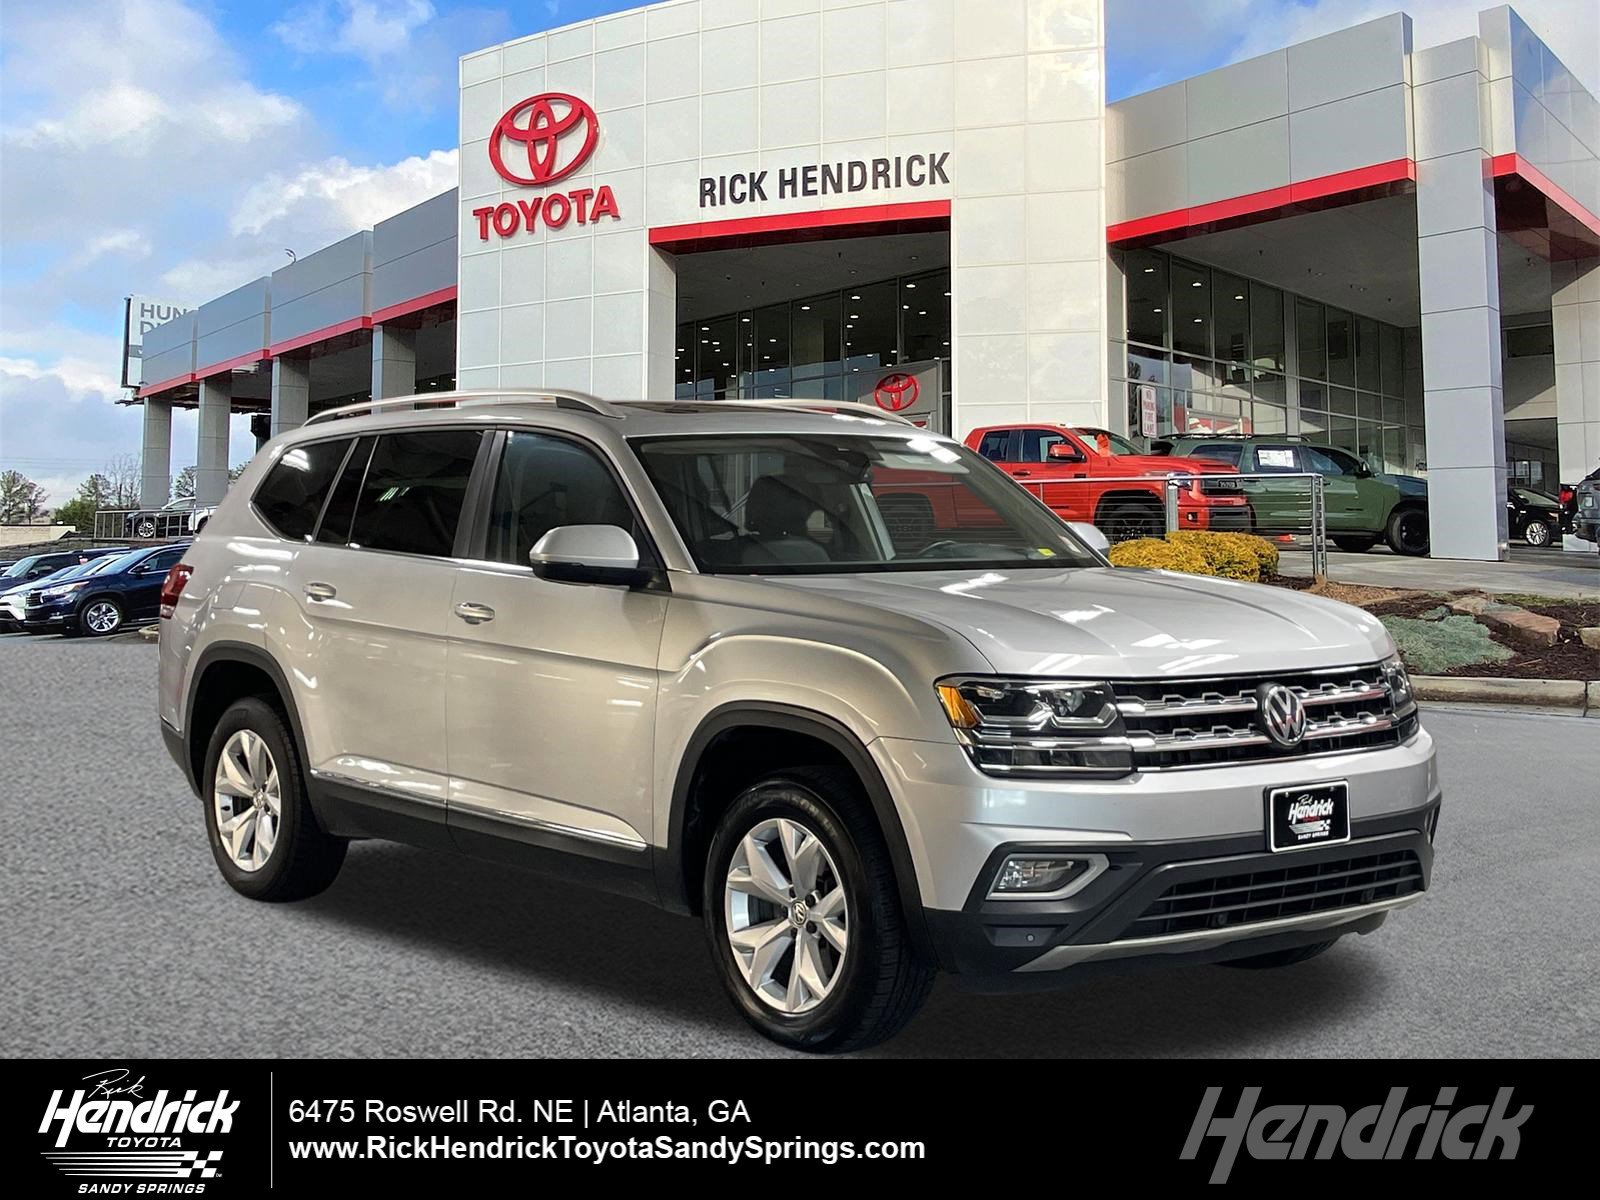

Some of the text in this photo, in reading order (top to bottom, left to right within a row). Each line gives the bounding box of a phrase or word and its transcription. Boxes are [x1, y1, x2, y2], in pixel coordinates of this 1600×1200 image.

[699, 152, 950, 208] RICK HENDRICK
[472, 185, 621, 241] TOYOTA
[1288, 798, 1334, 825] Hendrick
